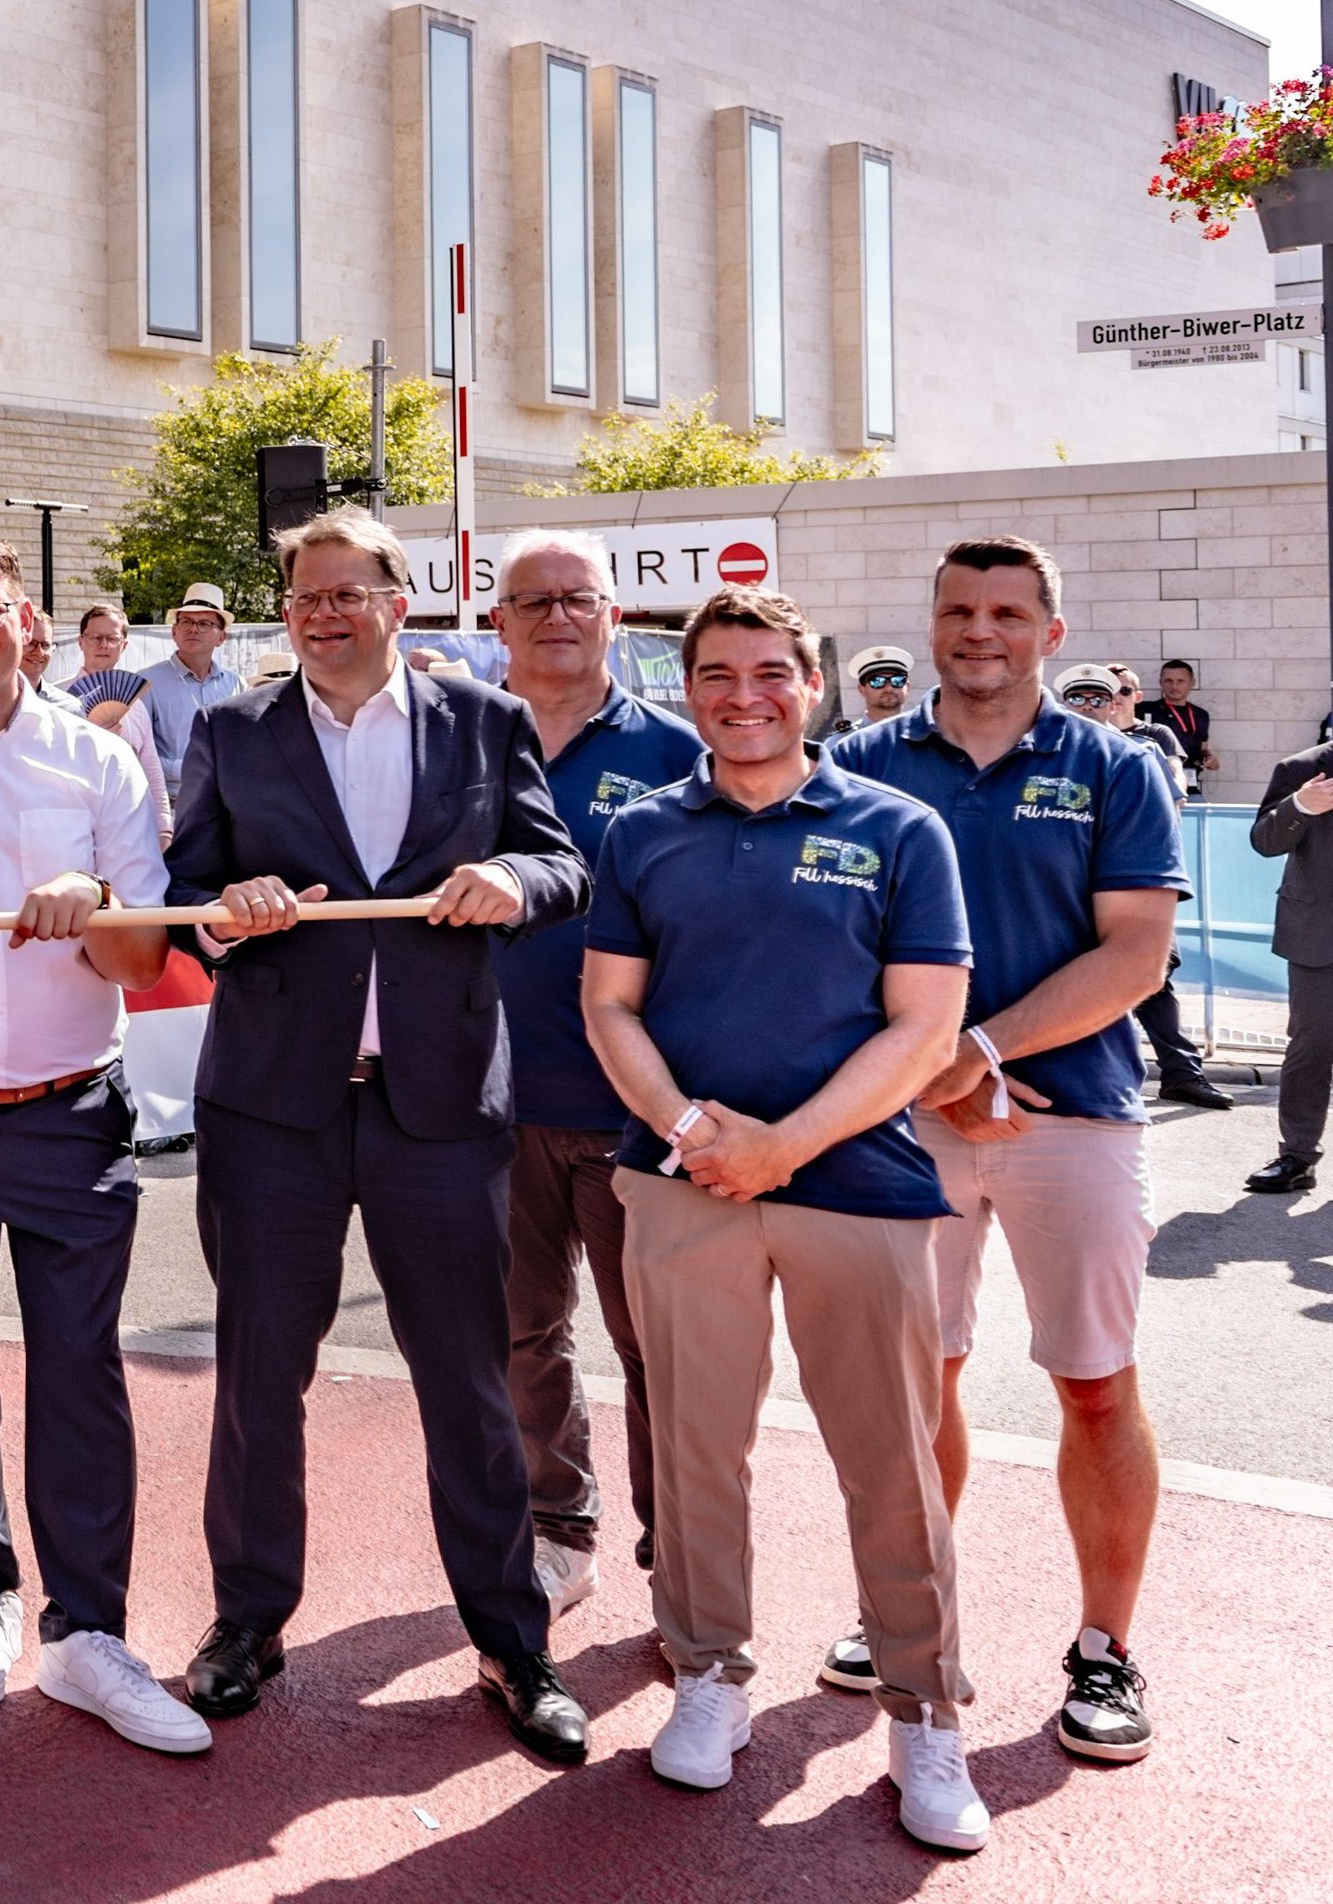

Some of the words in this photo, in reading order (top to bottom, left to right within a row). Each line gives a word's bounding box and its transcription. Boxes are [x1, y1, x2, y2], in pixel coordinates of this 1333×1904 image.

[1092, 313, 1305, 344] Günther-Biwer-Platz
[1138, 358, 1189, 368] Bürgermeister
[1023, 776, 1091, 810] FD
[801, 834, 881, 875] FD
[823, 870, 878, 891] hessisch
